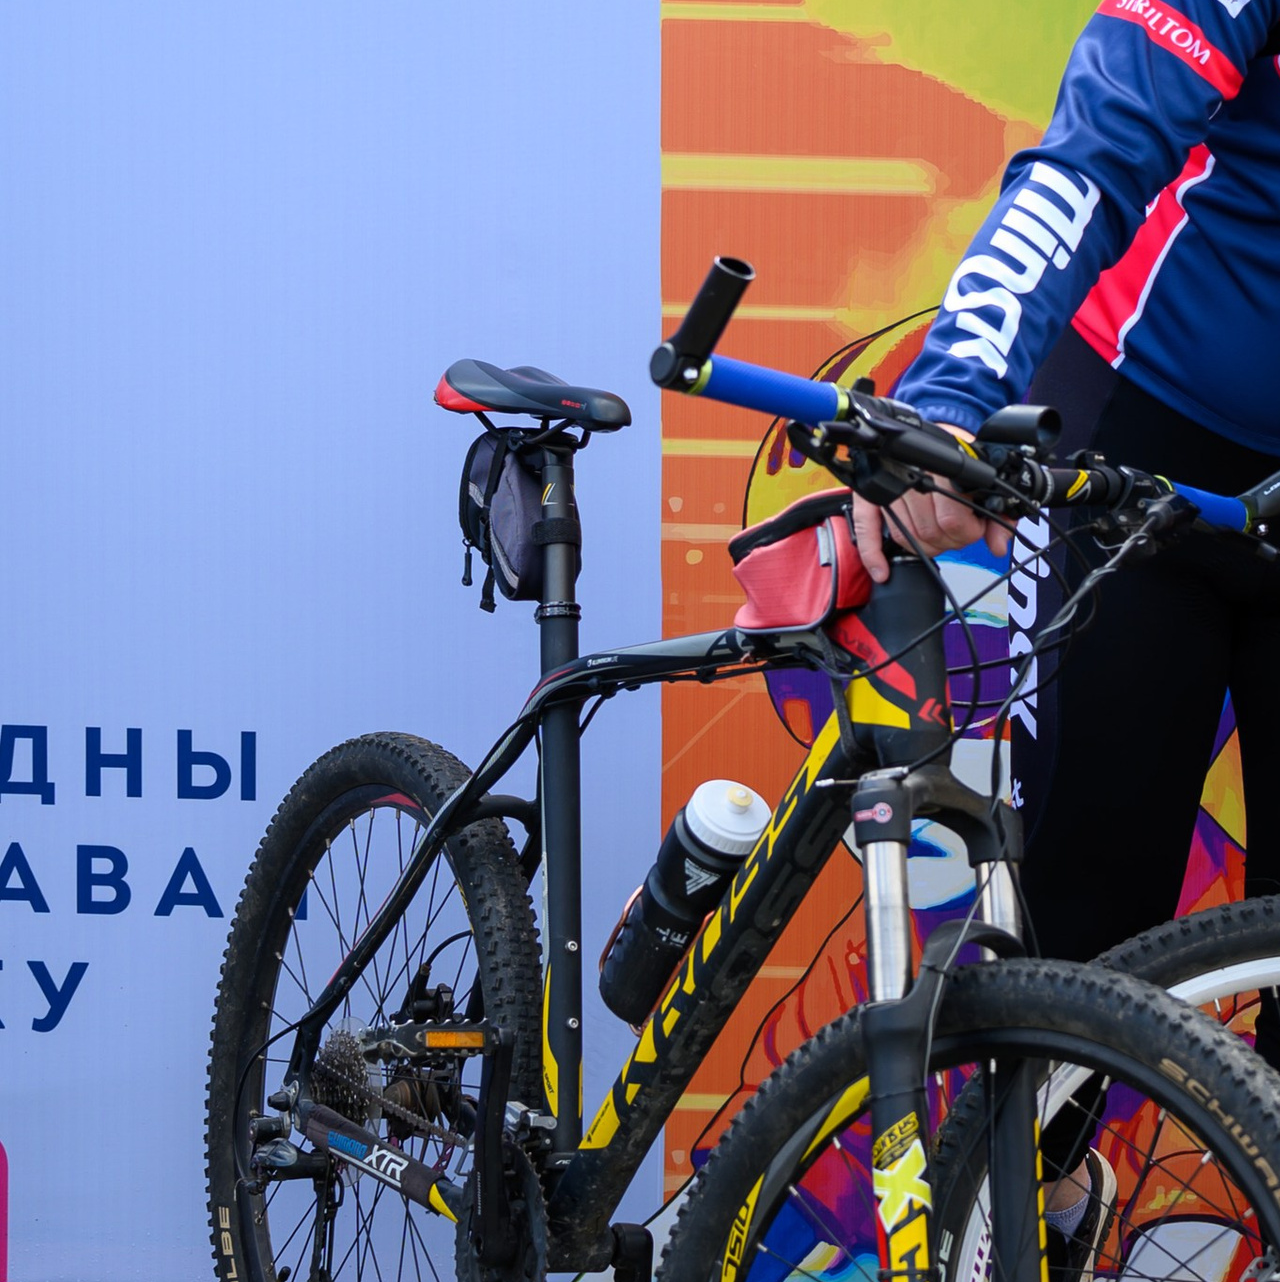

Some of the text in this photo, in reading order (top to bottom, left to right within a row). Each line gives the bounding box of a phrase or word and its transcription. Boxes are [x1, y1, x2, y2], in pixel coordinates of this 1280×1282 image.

[0, 724, 257, 805] ДНЫ
[0, 842, 308, 921] АВА
[0, 959, 90, 1033] У
[363, 1144, 410, 1181] XTR
